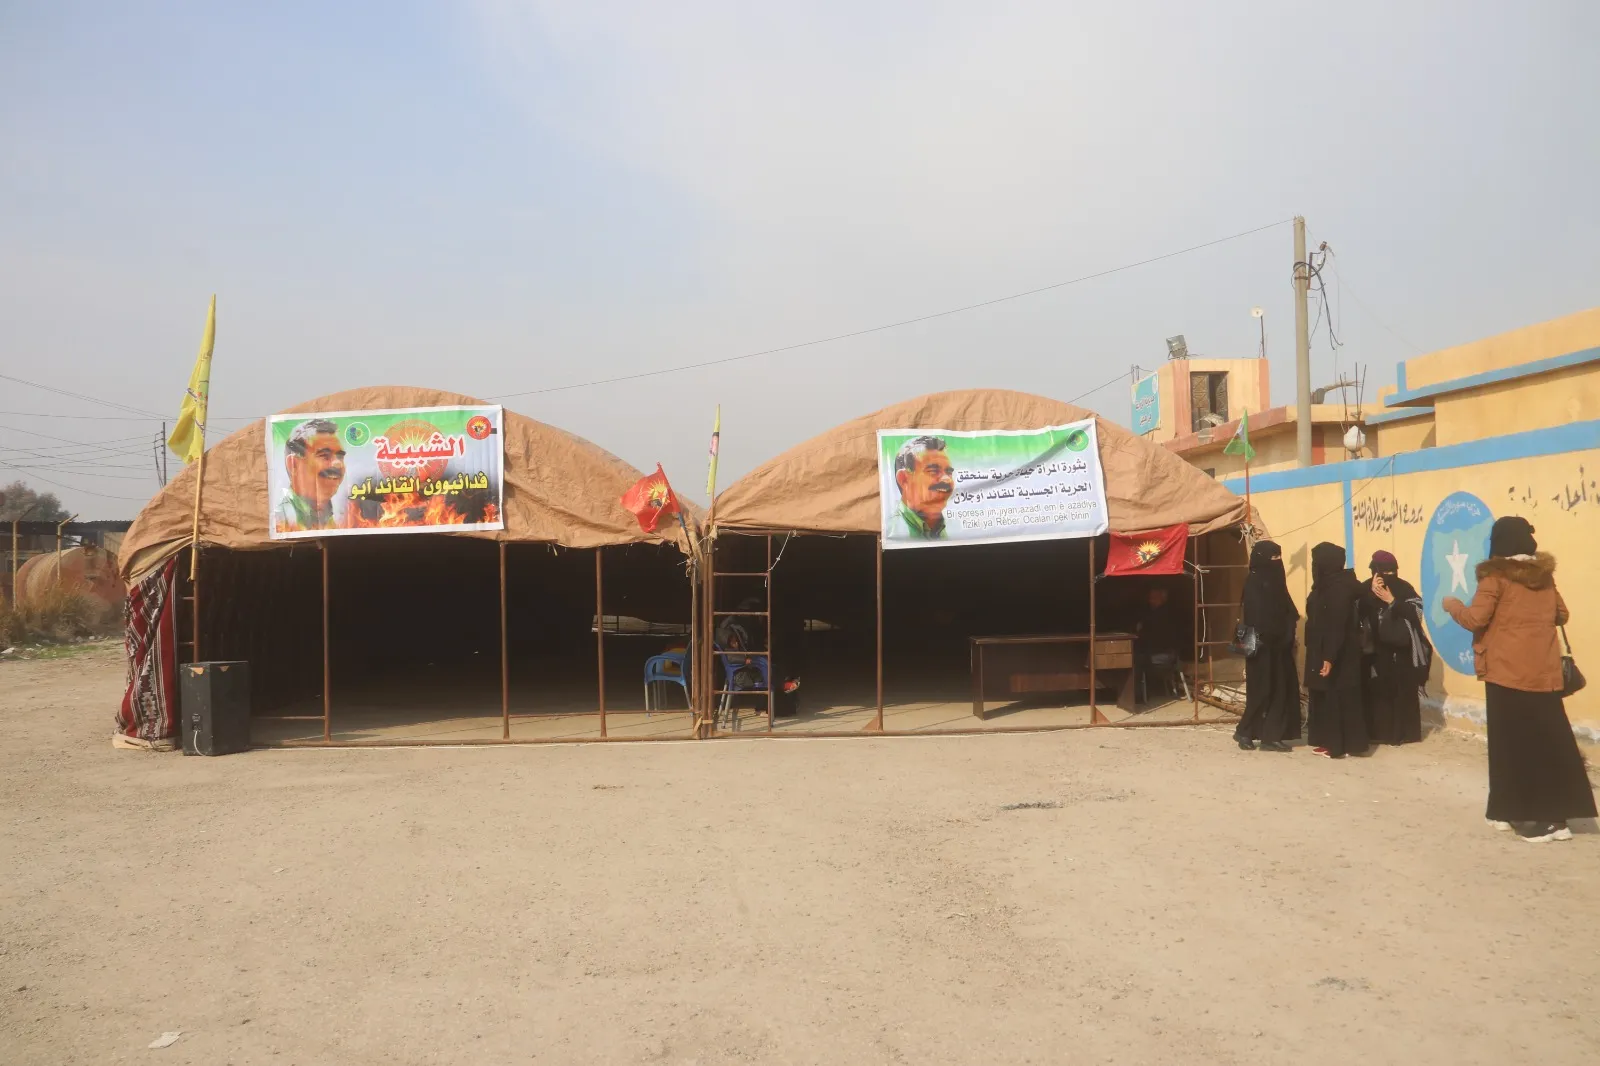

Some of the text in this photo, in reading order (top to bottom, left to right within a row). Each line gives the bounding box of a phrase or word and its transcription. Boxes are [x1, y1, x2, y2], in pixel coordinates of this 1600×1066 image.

[373, 433, 465, 467] الشبيبة
[1037, 463, 1060, 476] المرأة
[1061, 459, 1086, 474] بثورة
[957, 470, 989, 483] سنحقق
[375, 476, 420, 494] القائد
[1017, 485, 1058, 500] الجسدية
[1059, 482, 1092, 497] الحرية
[1044, 503, 1057, 512] em
[983, 519, 993, 529] ya
